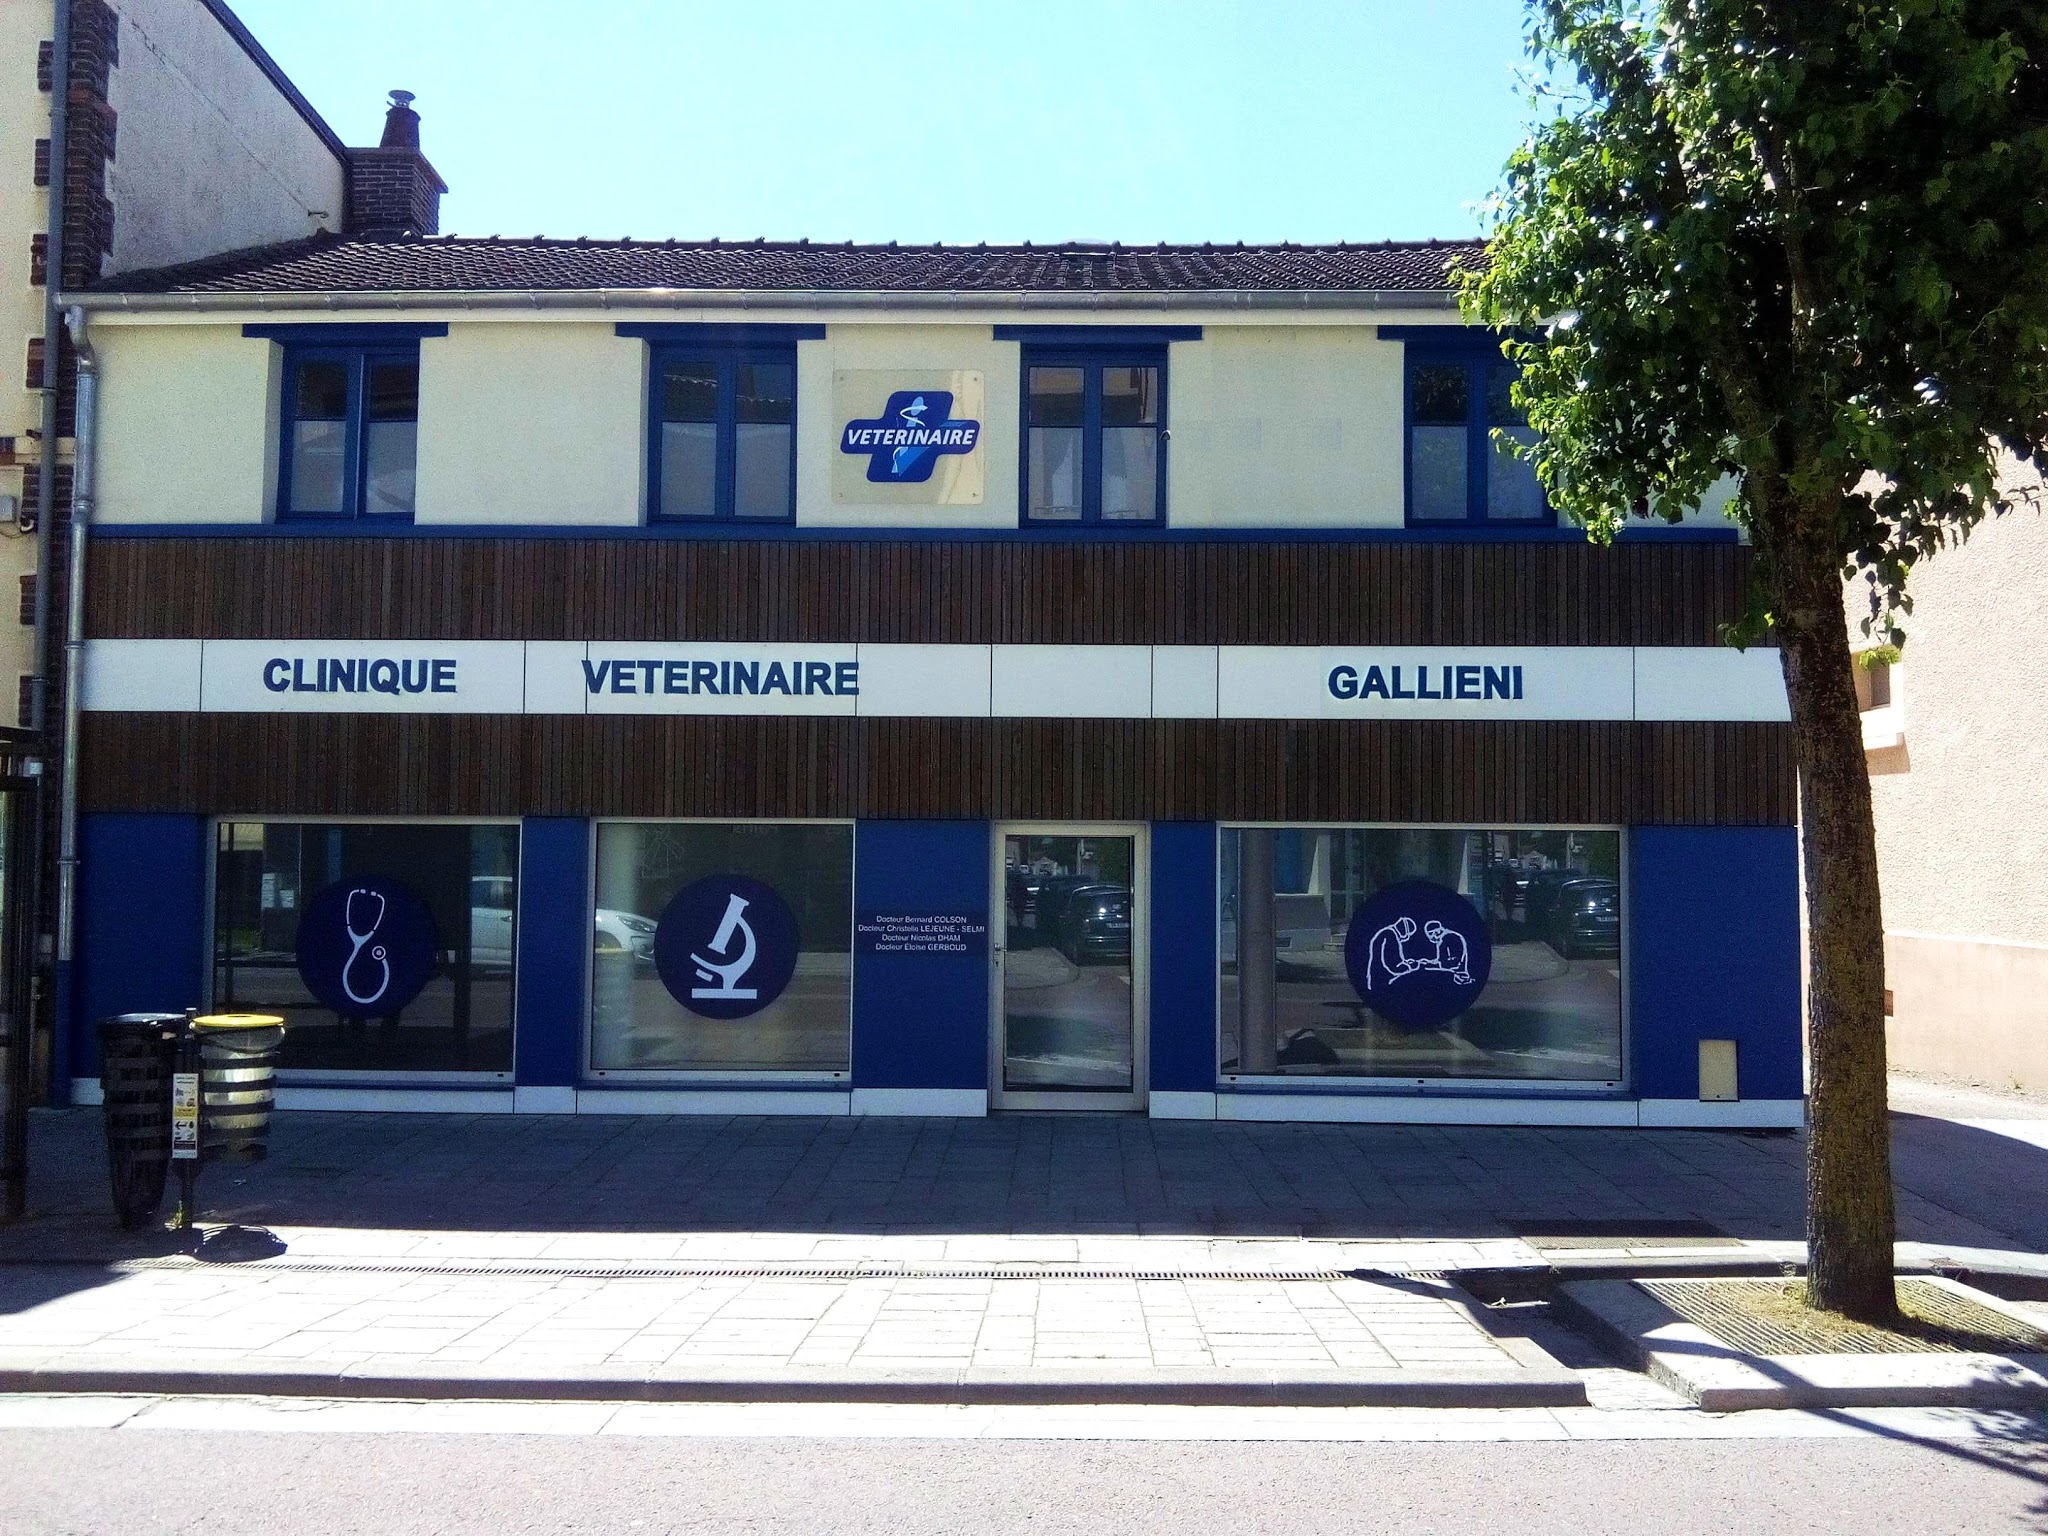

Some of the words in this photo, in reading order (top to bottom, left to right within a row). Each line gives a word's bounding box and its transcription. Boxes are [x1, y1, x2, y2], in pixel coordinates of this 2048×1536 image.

[848, 429, 975, 445] VETERINAIRE
[263, 658, 457, 695] CLINIQUE
[581, 660, 859, 695] VETERINAIRE
[1328, 665, 1523, 700] GALLIENI
[876, 915, 903, 923] Docteur
[905, 915, 933, 923] Bernard
[934, 916, 967, 924] COLSON
[858, 924, 885, 932] Docteur
[961, 925, 985, 933] SELMI
[937, 934, 961, 942] DHAM
[875, 943, 903, 951] Docteur
[927, 943, 967, 951] GERBOUD
